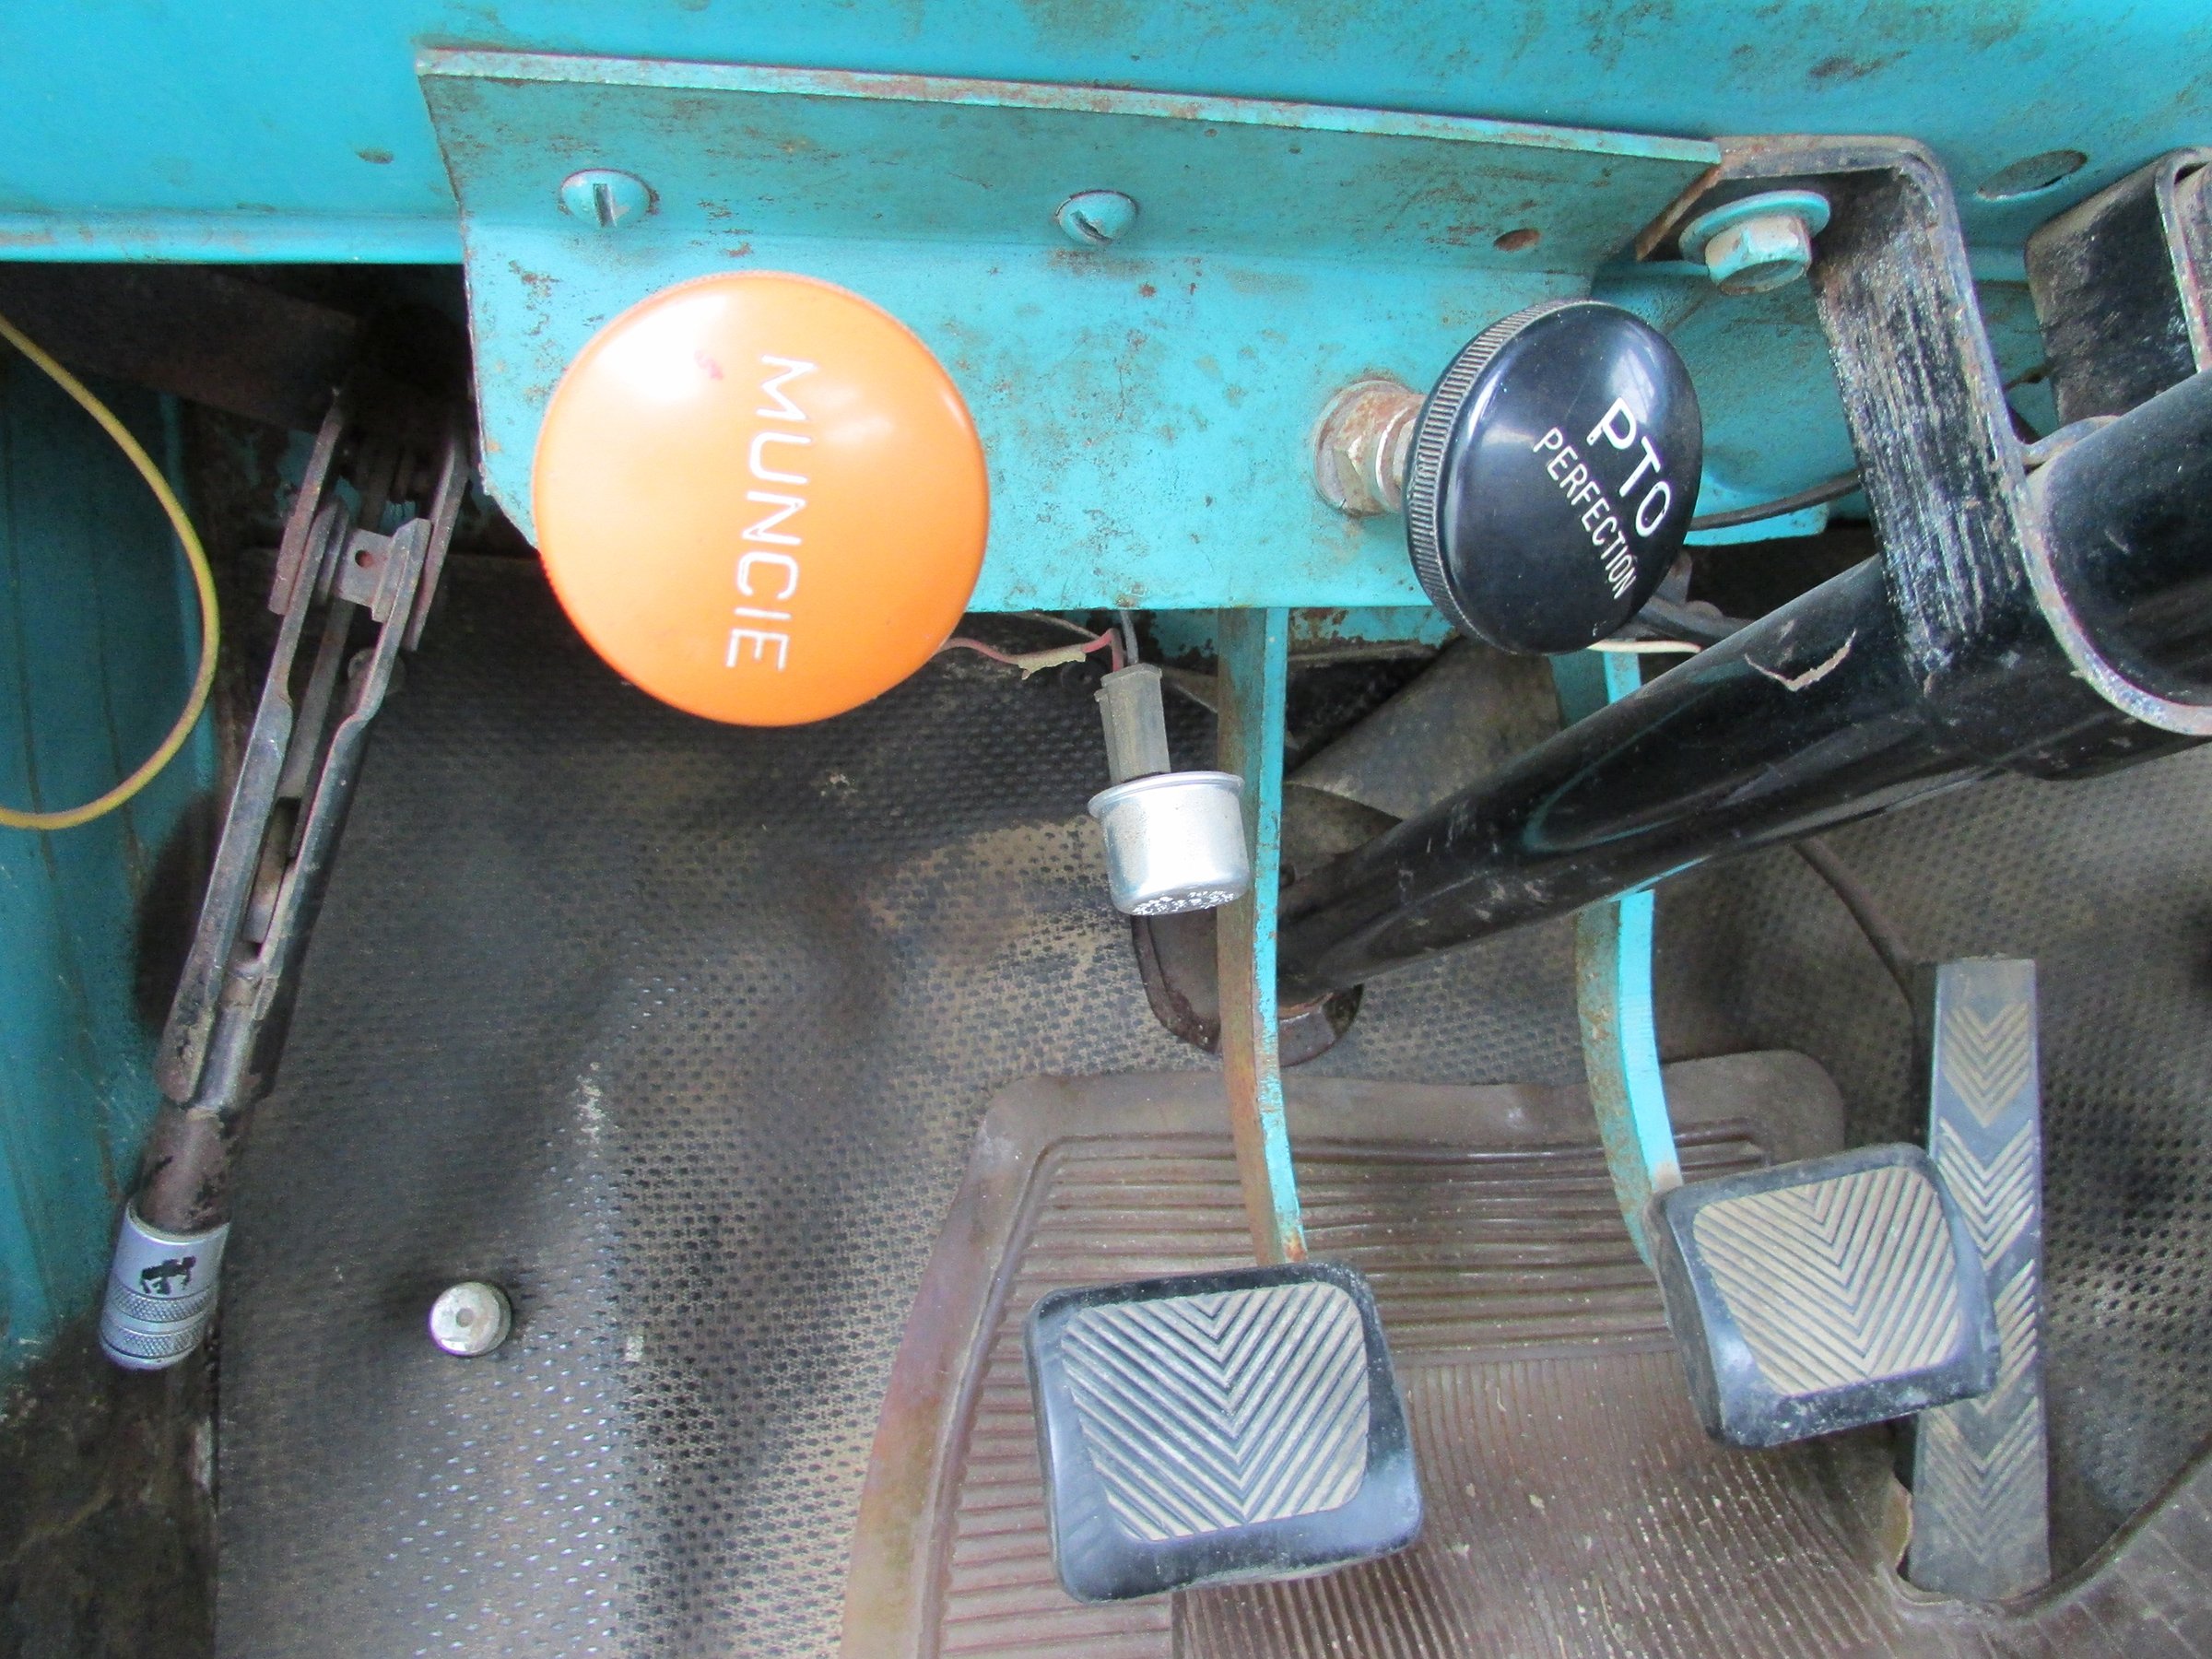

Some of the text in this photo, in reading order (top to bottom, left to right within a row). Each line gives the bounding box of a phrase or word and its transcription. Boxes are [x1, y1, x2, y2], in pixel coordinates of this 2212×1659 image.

[725, 354, 818, 671] MUNCIE
[1533, 427, 1638, 599] PERFECTION
[1586, 397, 1671, 537] PTO
